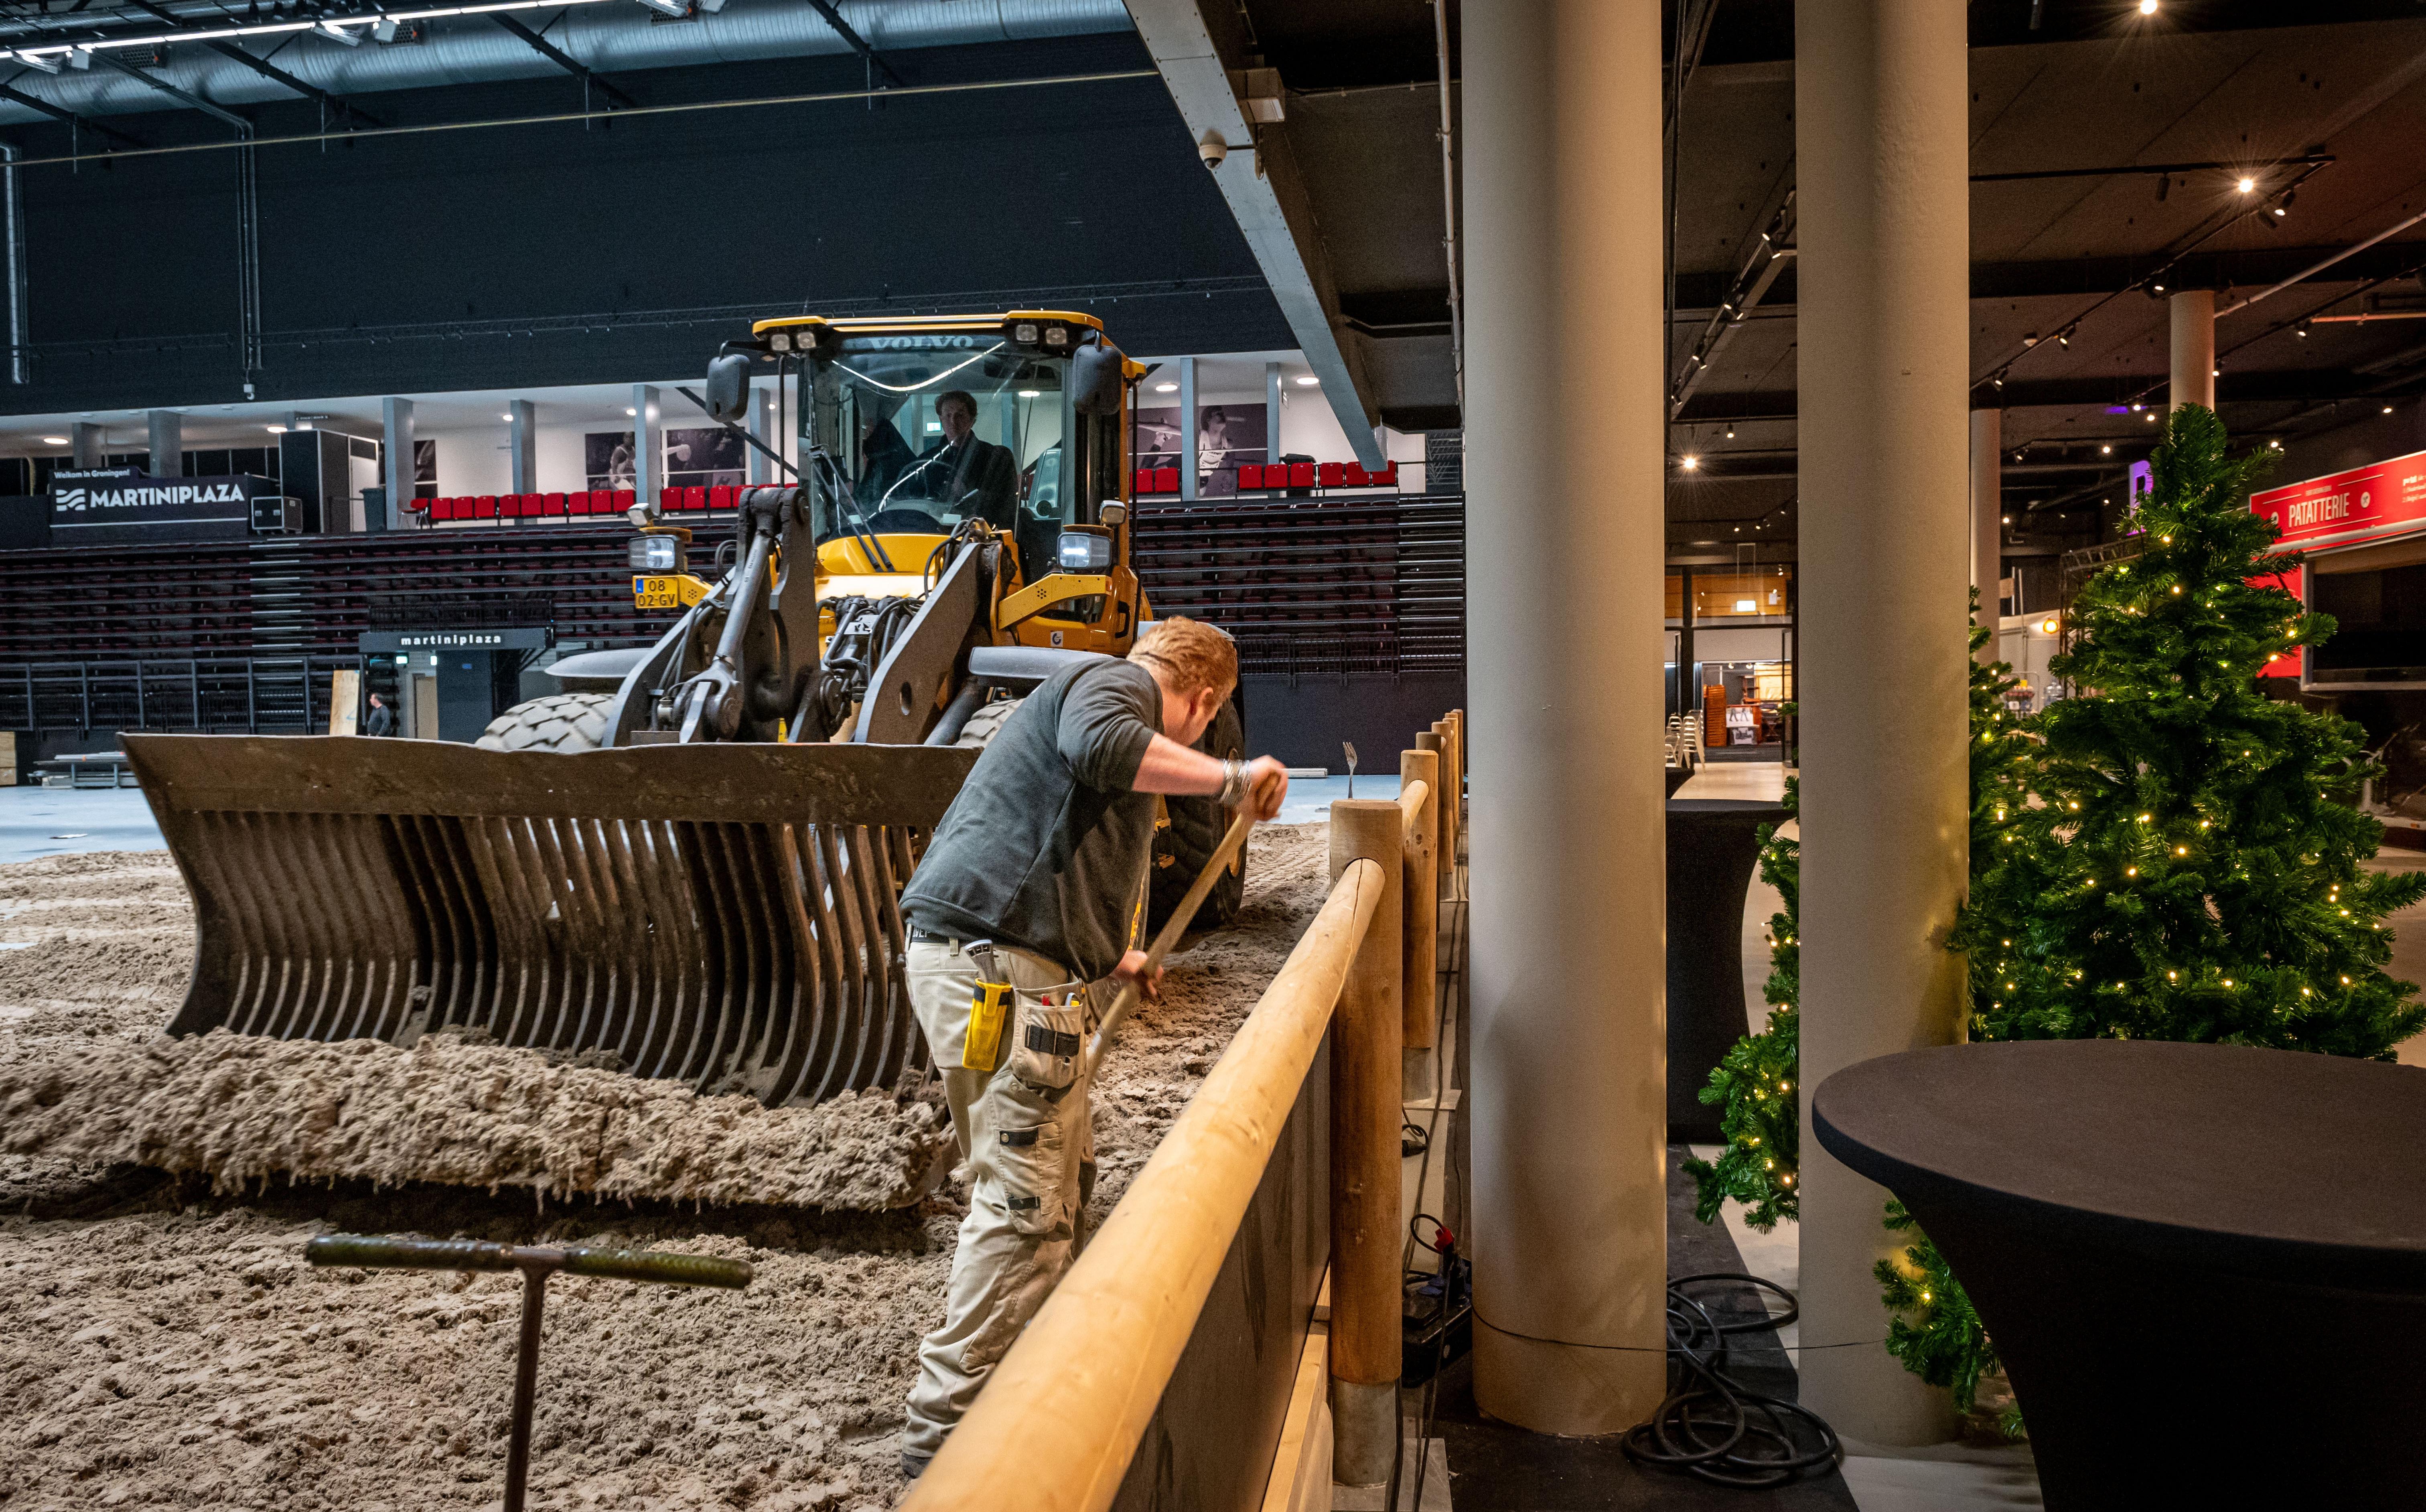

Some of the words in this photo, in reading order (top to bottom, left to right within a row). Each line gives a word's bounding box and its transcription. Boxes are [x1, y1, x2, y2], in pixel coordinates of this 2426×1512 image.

[868, 335, 974, 349] VOLVO
[91, 468, 130, 478] Groningen!
[90, 484, 245, 508] MARTINIPLAZA
[2288, 492, 2350, 528] PATATTERIE
[649, 580, 665, 591] 08
[638, 594, 675, 606] 02-GV
[401, 634, 501, 646] martiniplaza
